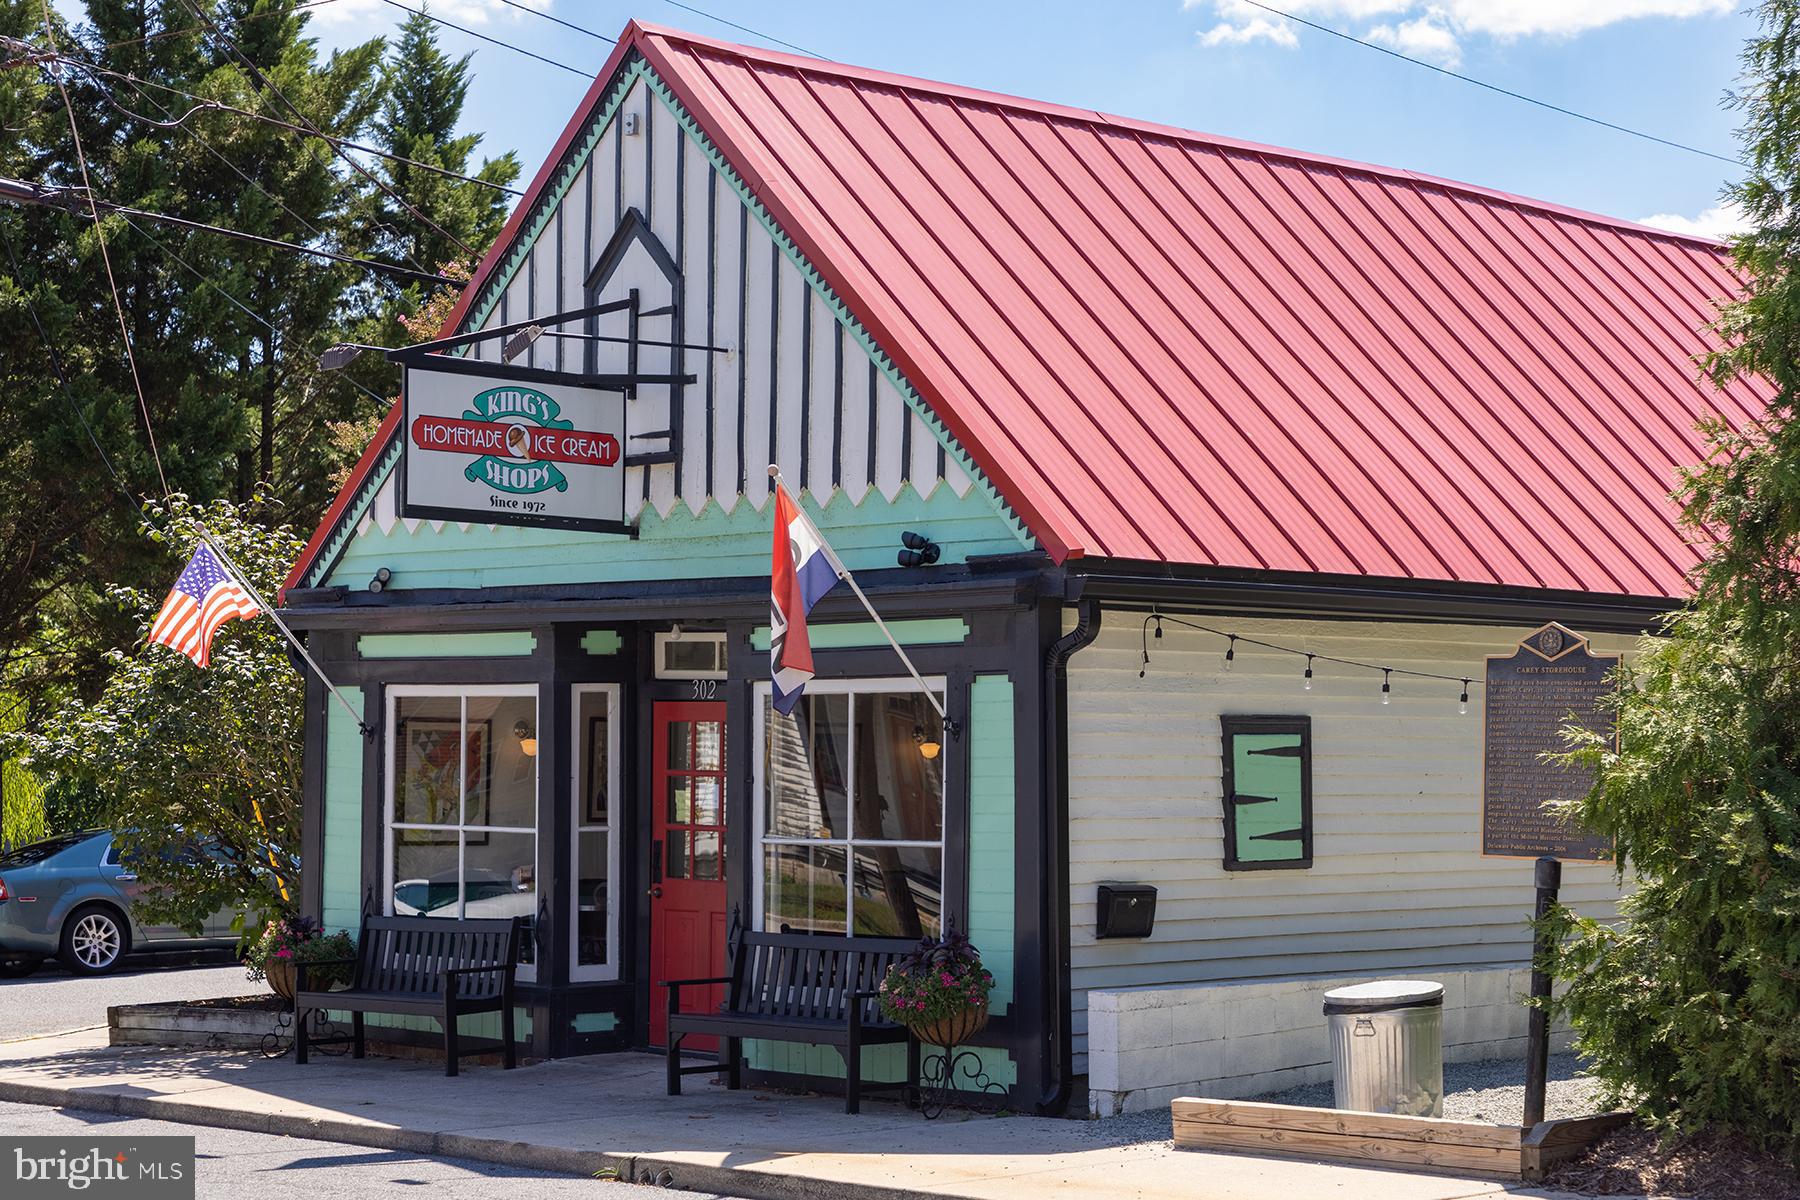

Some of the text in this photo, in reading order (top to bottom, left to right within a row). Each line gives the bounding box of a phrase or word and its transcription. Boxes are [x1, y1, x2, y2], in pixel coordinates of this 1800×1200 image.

[488, 392, 549, 420] KING'S
[424, 424, 610, 460] HOMEMADE ICE CREAM
[486, 460, 550, 488] SHOPS
[490, 496, 546, 512] Since 1972
[692, 680, 716, 700] 302
